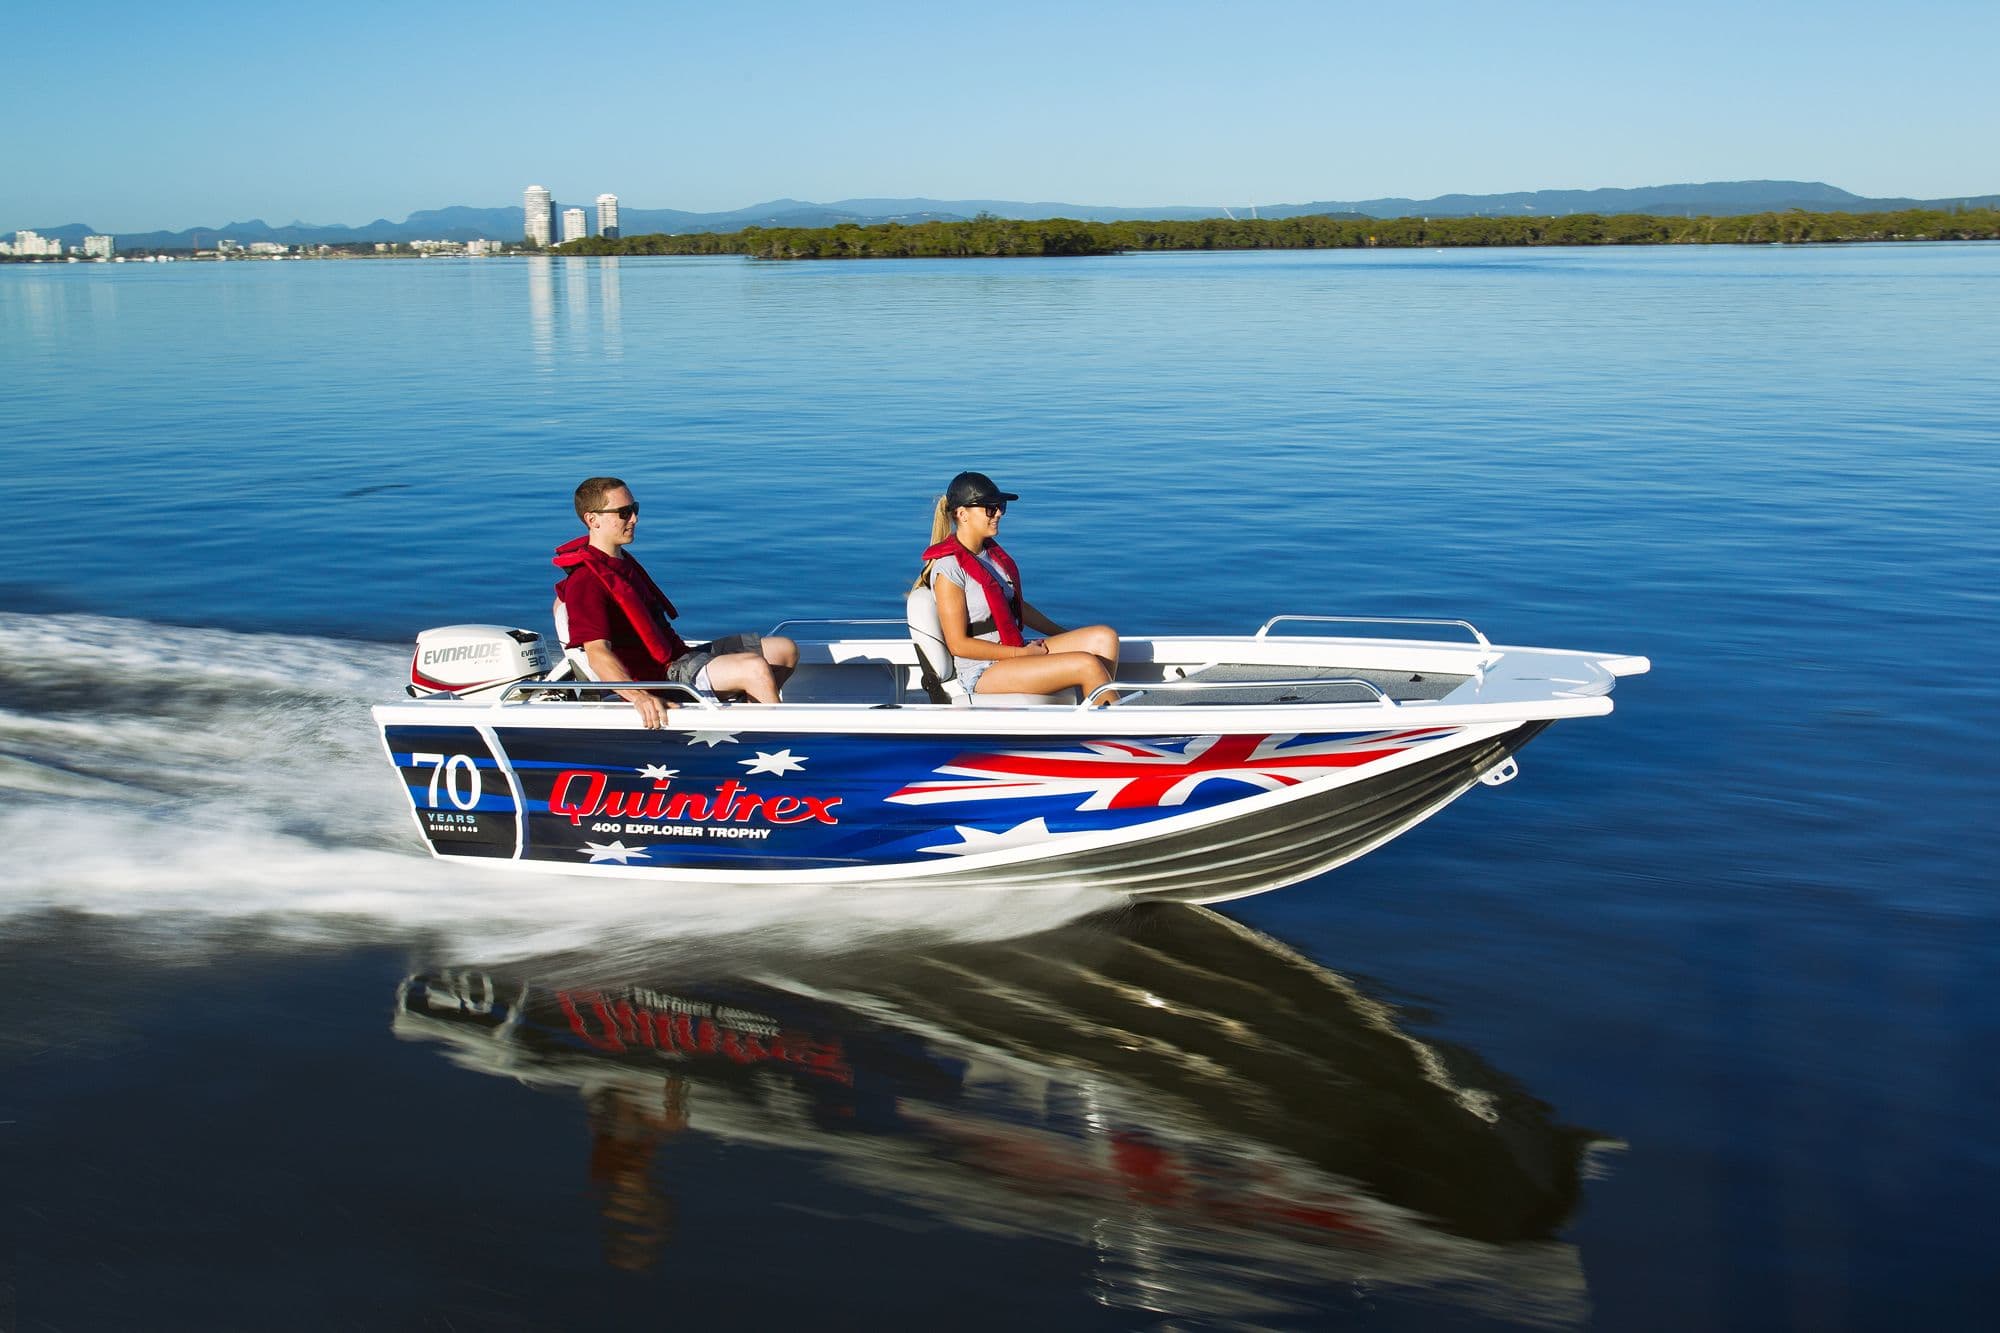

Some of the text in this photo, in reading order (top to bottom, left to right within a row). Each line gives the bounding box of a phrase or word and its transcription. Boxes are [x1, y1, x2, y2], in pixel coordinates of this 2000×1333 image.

[424, 643, 502, 665] EVINRUDE
[528, 655, 546, 667] 30
[412, 752, 481, 810] 70
[549, 769, 843, 826] Quintrex
[427, 813, 476, 824] YEARS
[430, 824, 455, 832] SINCE
[592, 823, 771, 839] 400 EXPLORER TROPHY
